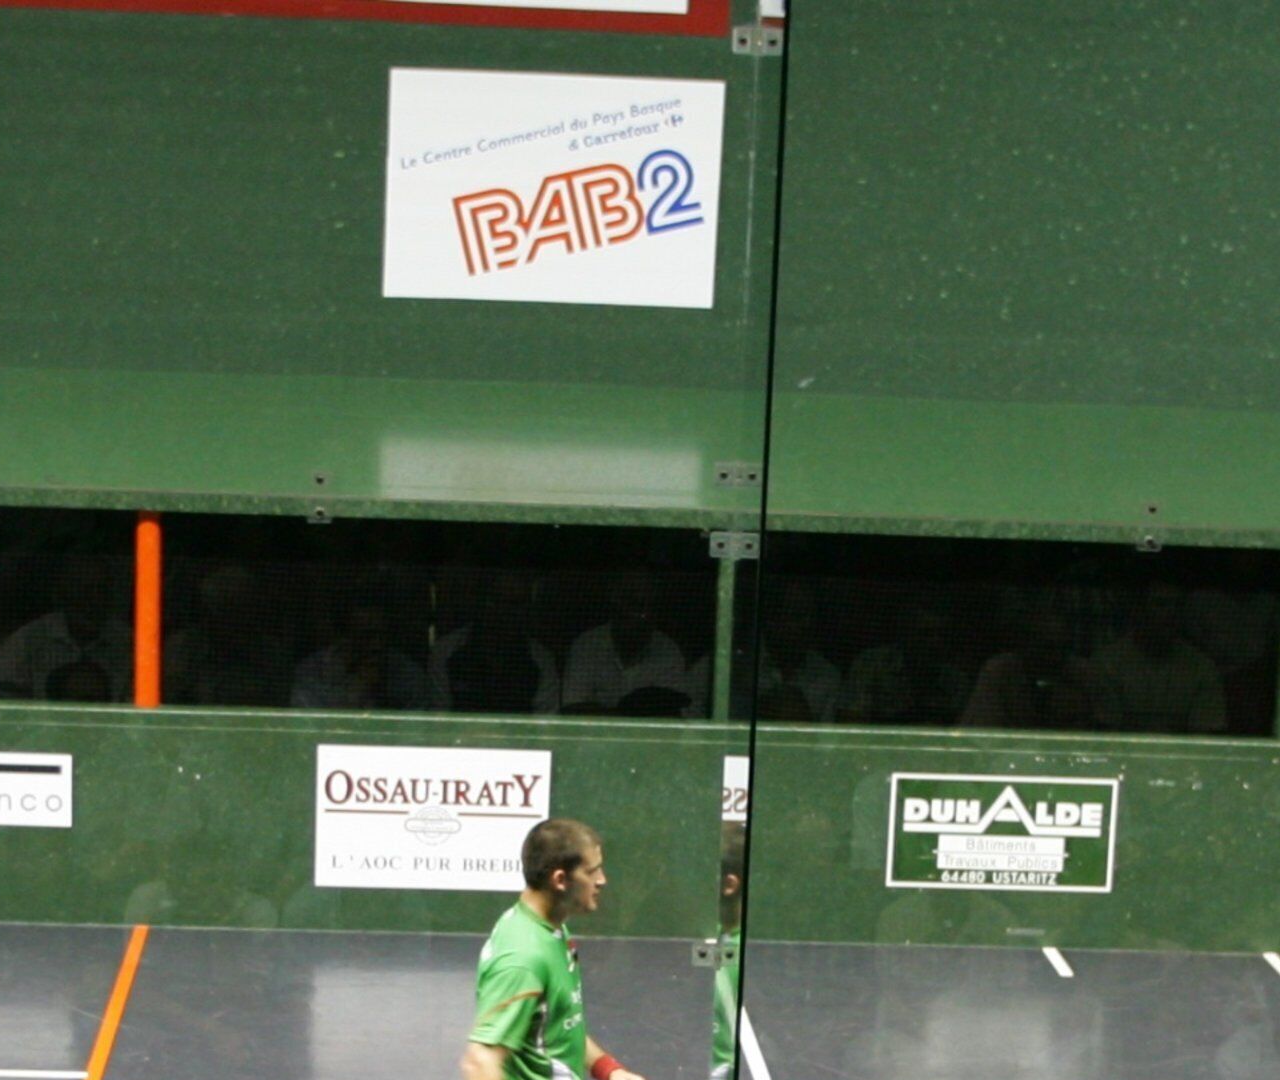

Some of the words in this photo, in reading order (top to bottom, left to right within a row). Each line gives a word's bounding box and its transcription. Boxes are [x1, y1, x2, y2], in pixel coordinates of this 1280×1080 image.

[423, 144, 472, 165] Centre
[477, 121, 566, 153] Commercial
[570, 117, 589, 132] du
[592, 111, 625, 128] Pays
[630, 98, 682, 119] Basque
[584, 123, 661, 149] Carrefour
[451, 149, 705, 277] BAB2
[324, 769, 542, 808] OSSAU-IRATY
[413, 856, 451, 872] PUR
[462, 858, 524, 874] BREBI
[944, 853, 997, 869] Travaux
[1007, 856, 1058, 870] Publics
[941, 871, 986, 883] 64480
[992, 872, 1057, 886] USTARITZ
